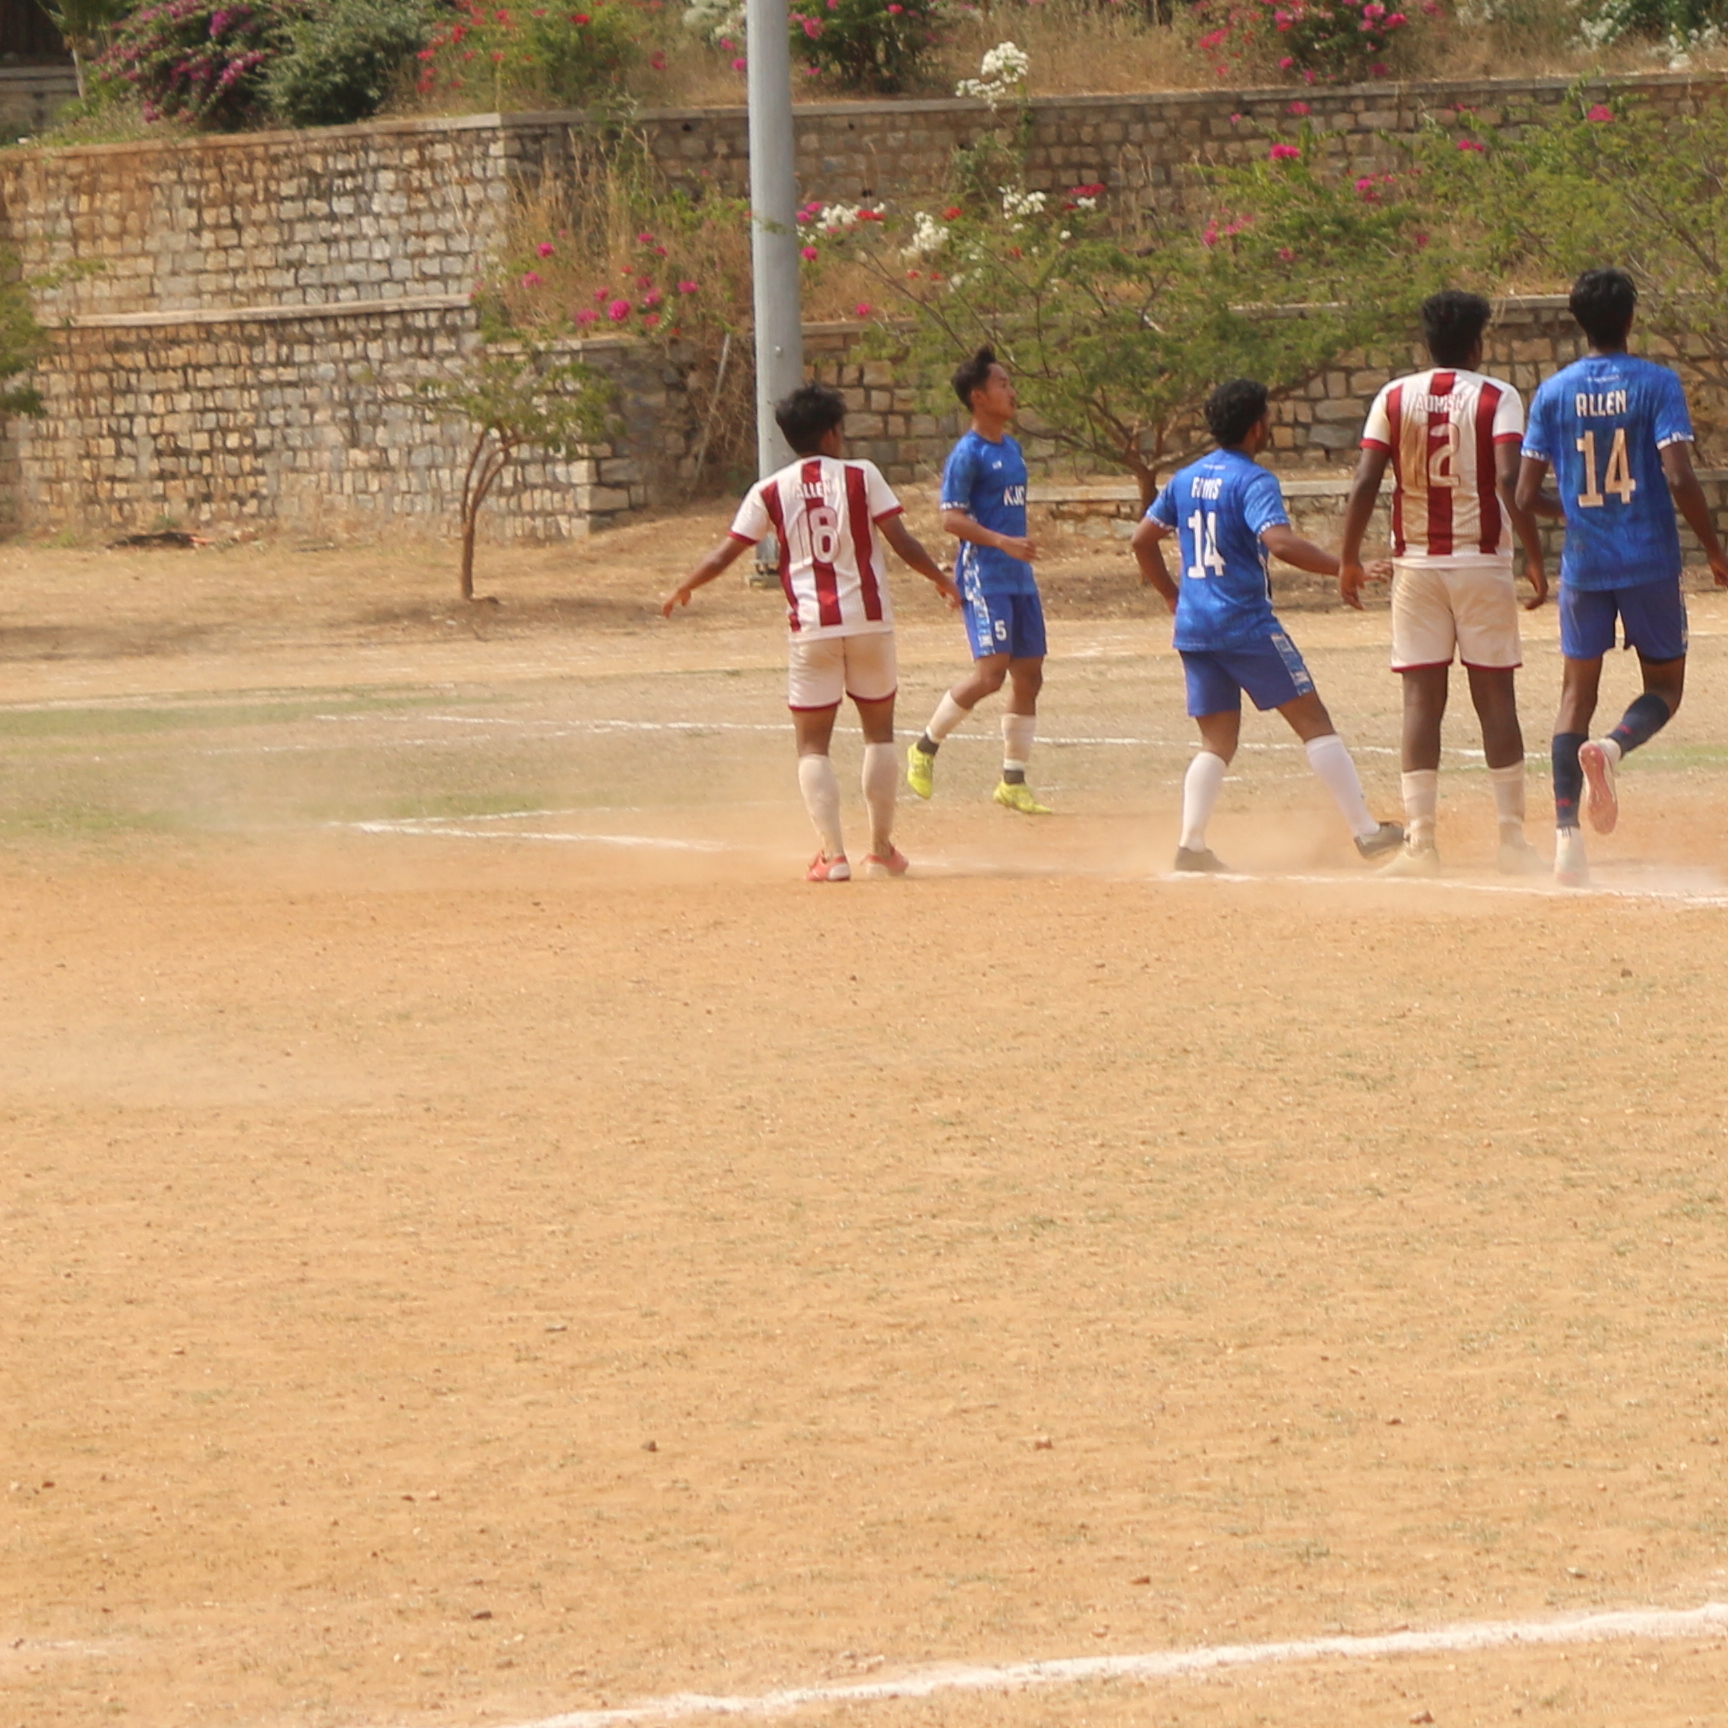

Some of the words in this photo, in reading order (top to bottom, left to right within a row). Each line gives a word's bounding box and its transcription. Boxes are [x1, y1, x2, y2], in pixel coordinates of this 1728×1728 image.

[1575, 389, 1627, 418] ALLEN
[1576, 427, 1636, 508] 14
[797, 505, 840, 564] 18
[1187, 509, 1226, 579] 14
[994, 619, 1007, 642] 5
